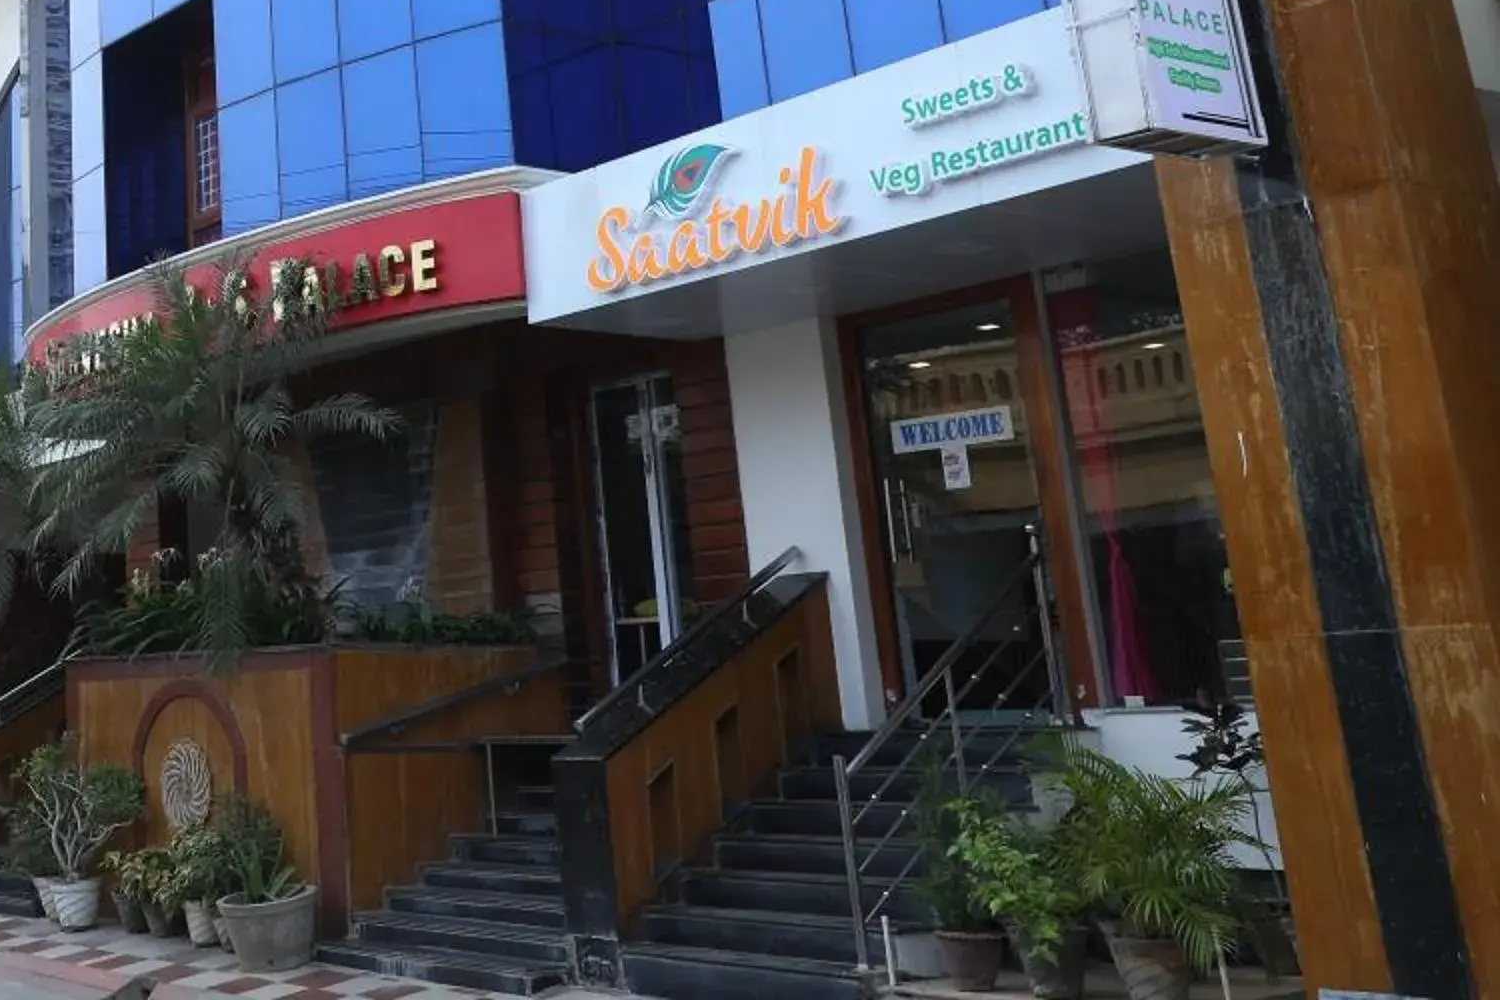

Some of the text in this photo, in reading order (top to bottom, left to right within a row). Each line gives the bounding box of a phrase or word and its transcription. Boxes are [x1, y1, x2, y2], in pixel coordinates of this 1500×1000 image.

[901, 64, 1024, 124] Sweets &
[870, 111, 1085, 194] Veg Restaurant
[587, 147, 841, 293] Saatvik
[900, 411, 1004, 446] WELCOME
